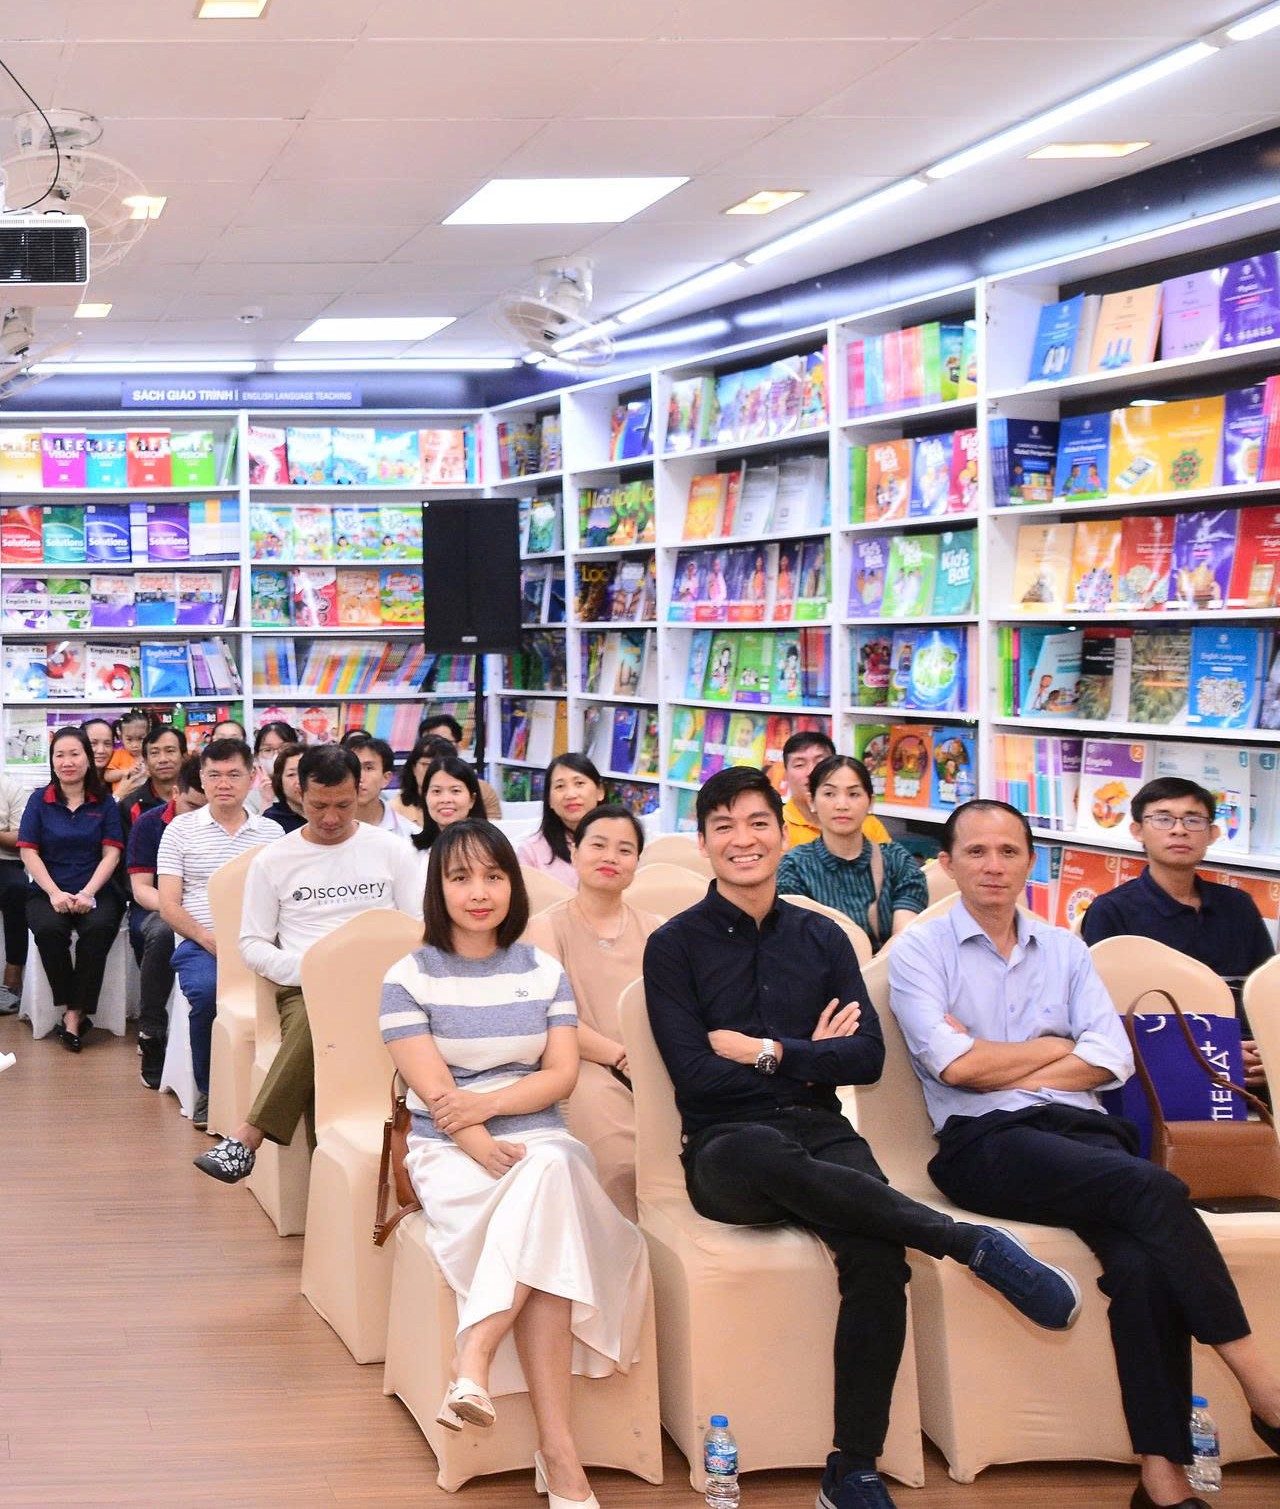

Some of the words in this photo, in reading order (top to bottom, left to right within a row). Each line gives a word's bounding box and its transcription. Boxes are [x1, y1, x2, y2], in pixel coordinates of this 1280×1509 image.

[2, 537, 41, 547] Solutions
[46, 537, 84, 547] Solutions
[88, 537, 128, 547] Solutions
[149, 536, 188, 546] Solutions
[5, 598, 29, 606] English
[1135, 746, 1143, 758] 2
[1086, 757, 1113, 768] English
[1240, 752, 1247, 766] 1
[1263, 755, 1271, 769] 1
[299, 882, 385, 900] Discovery
